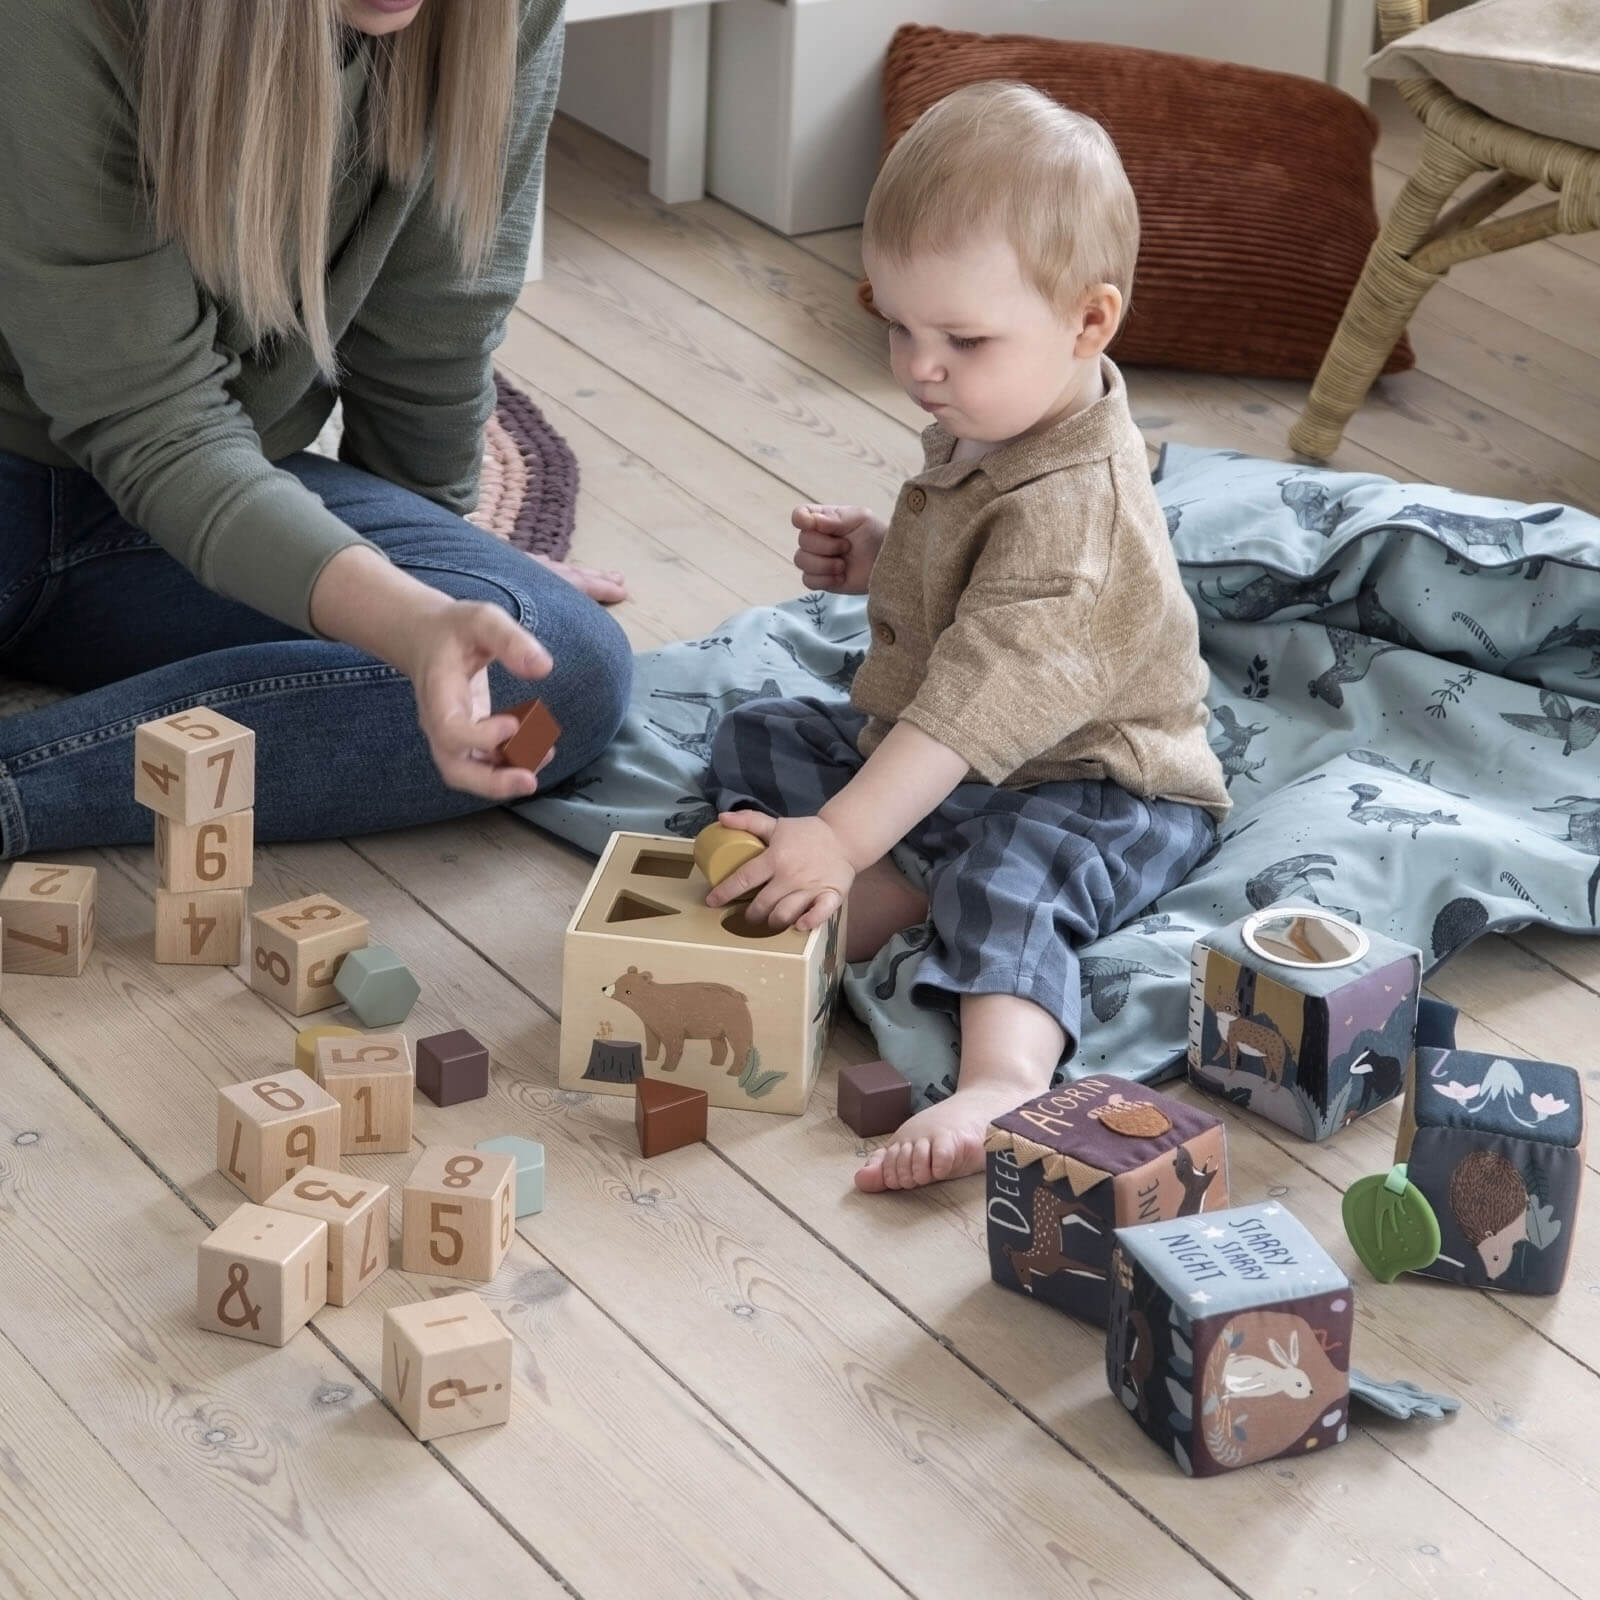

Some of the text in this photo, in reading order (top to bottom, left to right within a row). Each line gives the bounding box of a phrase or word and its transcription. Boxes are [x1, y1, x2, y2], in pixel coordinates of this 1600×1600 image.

[164, 715, 220, 740] 5
[141, 760, 179, 796] 4
[207, 748, 235, 809] 7
[196, 824, 227, 882] 6
[7, 924, 69, 956] 7
[182, 902, 217, 956] 4
[277, 904, 341, 930] 3
[255, 946, 290, 986] 8
[331, 1046, 400, 1064] 5
[353, 1086, 381, 1144] 1
[1019, 1079, 1111, 1136] ACORN
[442, 1155, 484, 1188] 8
[1138, 1178, 1161, 1222] NE
[429, 1202, 464, 1266] 5
[1160, 1233, 1228, 1281] NIGHT
[1228, 1218, 1299, 1266] STARRY
[1213, 1241, 1271, 1281] STARRY
[216, 1262, 262, 1331] &
